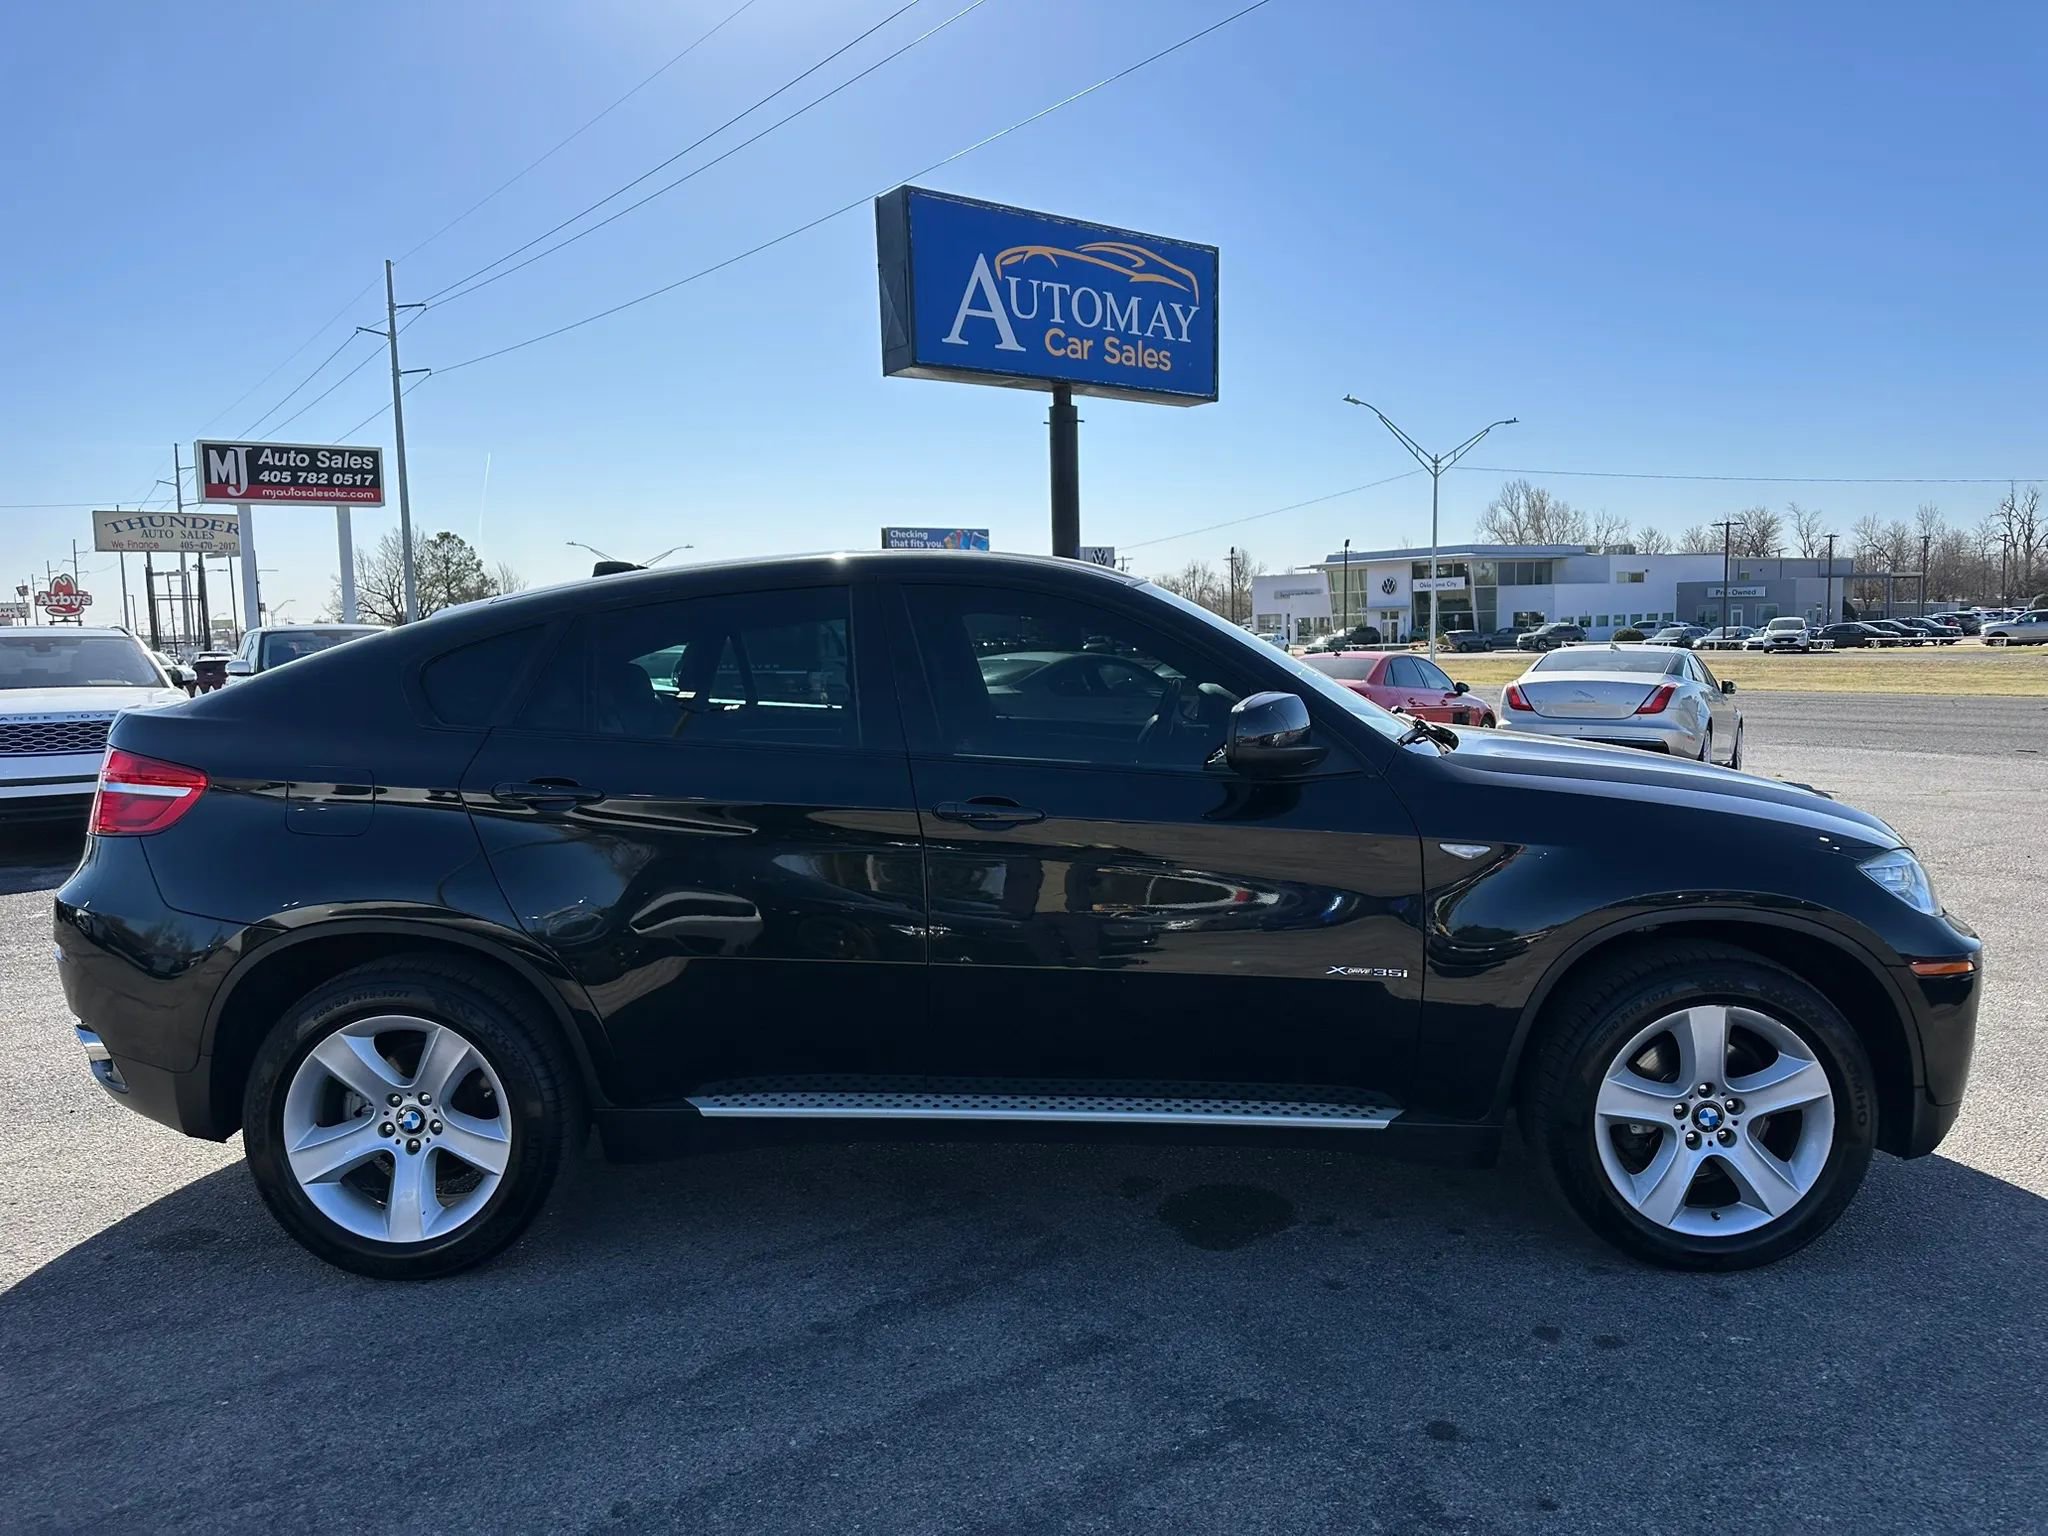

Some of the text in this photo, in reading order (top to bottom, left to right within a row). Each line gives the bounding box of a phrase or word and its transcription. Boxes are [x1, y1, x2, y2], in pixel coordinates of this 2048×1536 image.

[1044, 328, 1172, 372] Car Sales
[258, 448, 374, 469] Auto Sales
[208, 446, 253, 497] MJ
[258, 470, 374, 487] 405 782 0517
[262, 486, 374, 499] mjautosalesokc.com
[104, 515, 240, 537] THUNDER
[141, 529, 215, 540] AUTO SALES
[890, 530, 928, 540] Checking
[111, 540, 160, 550] We Finance
[180, 541, 236, 551] 405-470-2017
[890, 539, 944, 550] that fits you.
[37, 592, 92, 609] Arby's
